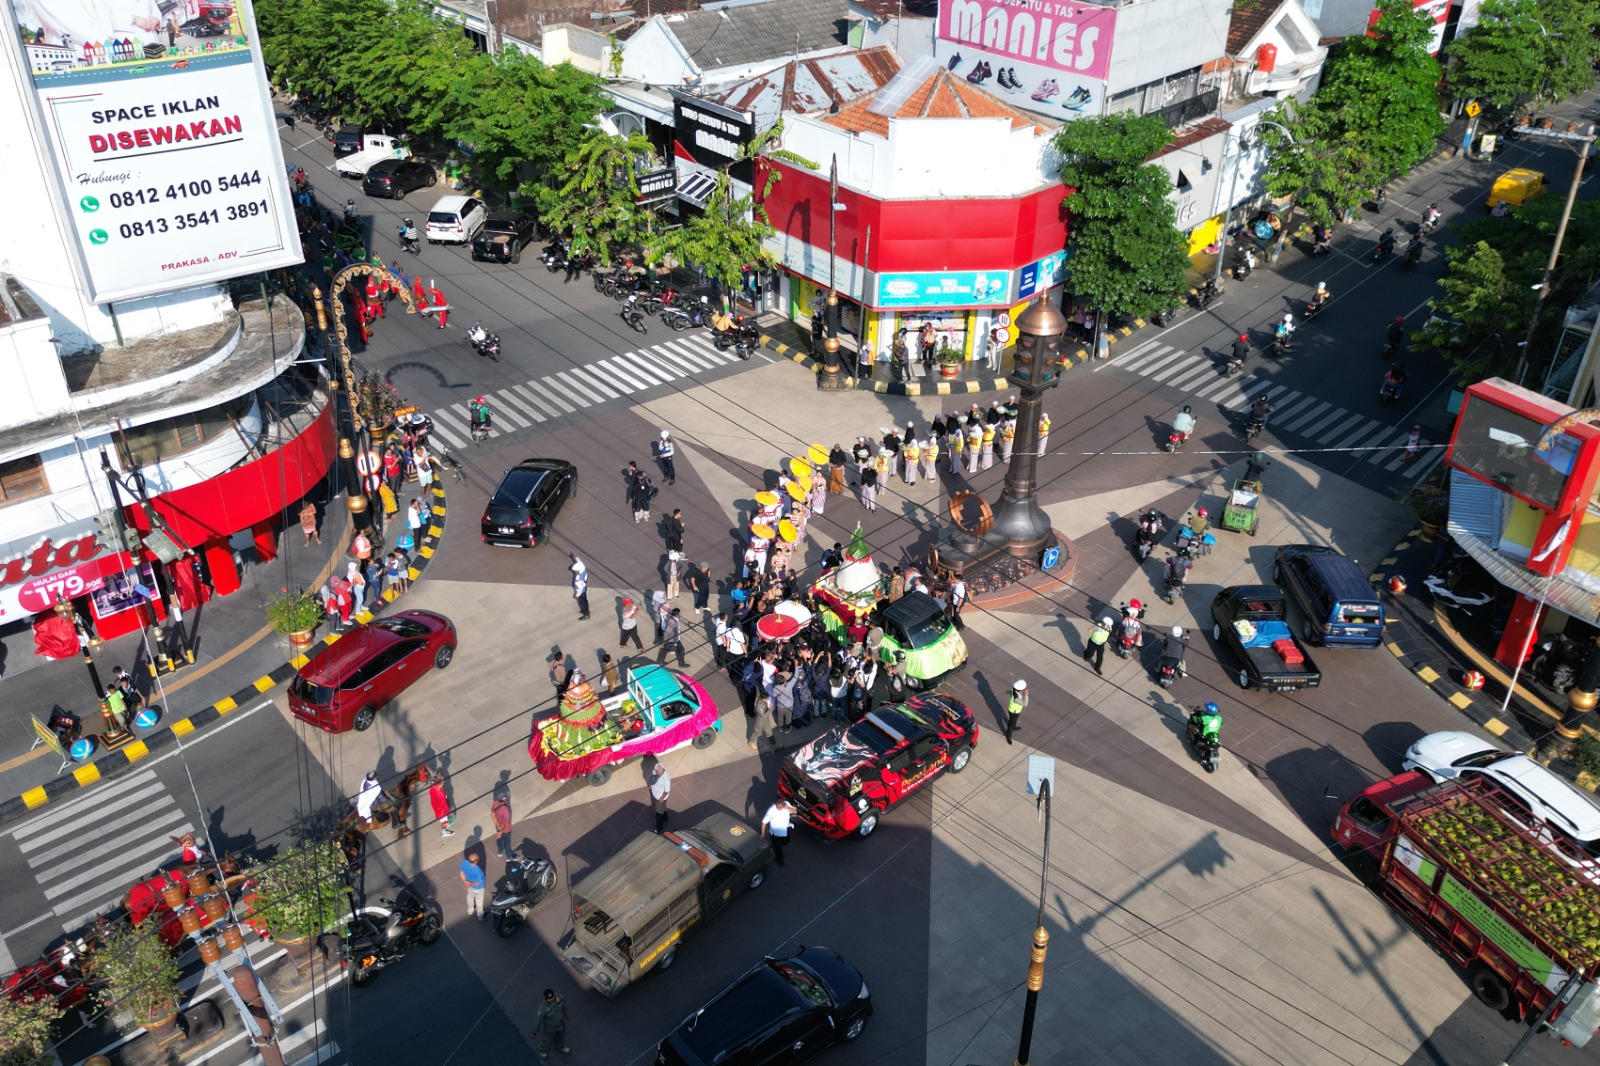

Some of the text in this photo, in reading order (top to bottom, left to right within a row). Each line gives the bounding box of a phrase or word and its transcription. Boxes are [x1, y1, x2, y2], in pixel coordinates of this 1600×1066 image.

[1044, 3, 1052, 14] &
[1054, 4, 1073, 18] TAS
[950, 1, 1099, 70] MANIES
[92, 95, 220, 124] SPACE IKLAN
[89, 115, 243, 153] DISEWAKAN
[695, 129, 744, 161] MANIE
[77, 170, 131, 186] Hubungi
[109, 170, 262, 209] 0812 4100 5444
[641, 178, 674, 194] MANIES
[119, 200, 269, 239] 0813 3541 3891
[161, 257, 210, 271] PRAKASA
[218, 250, 238, 261] ADV
[0, 532, 106, 587] ata
[33, 568, 77, 587] MULAI DARI
